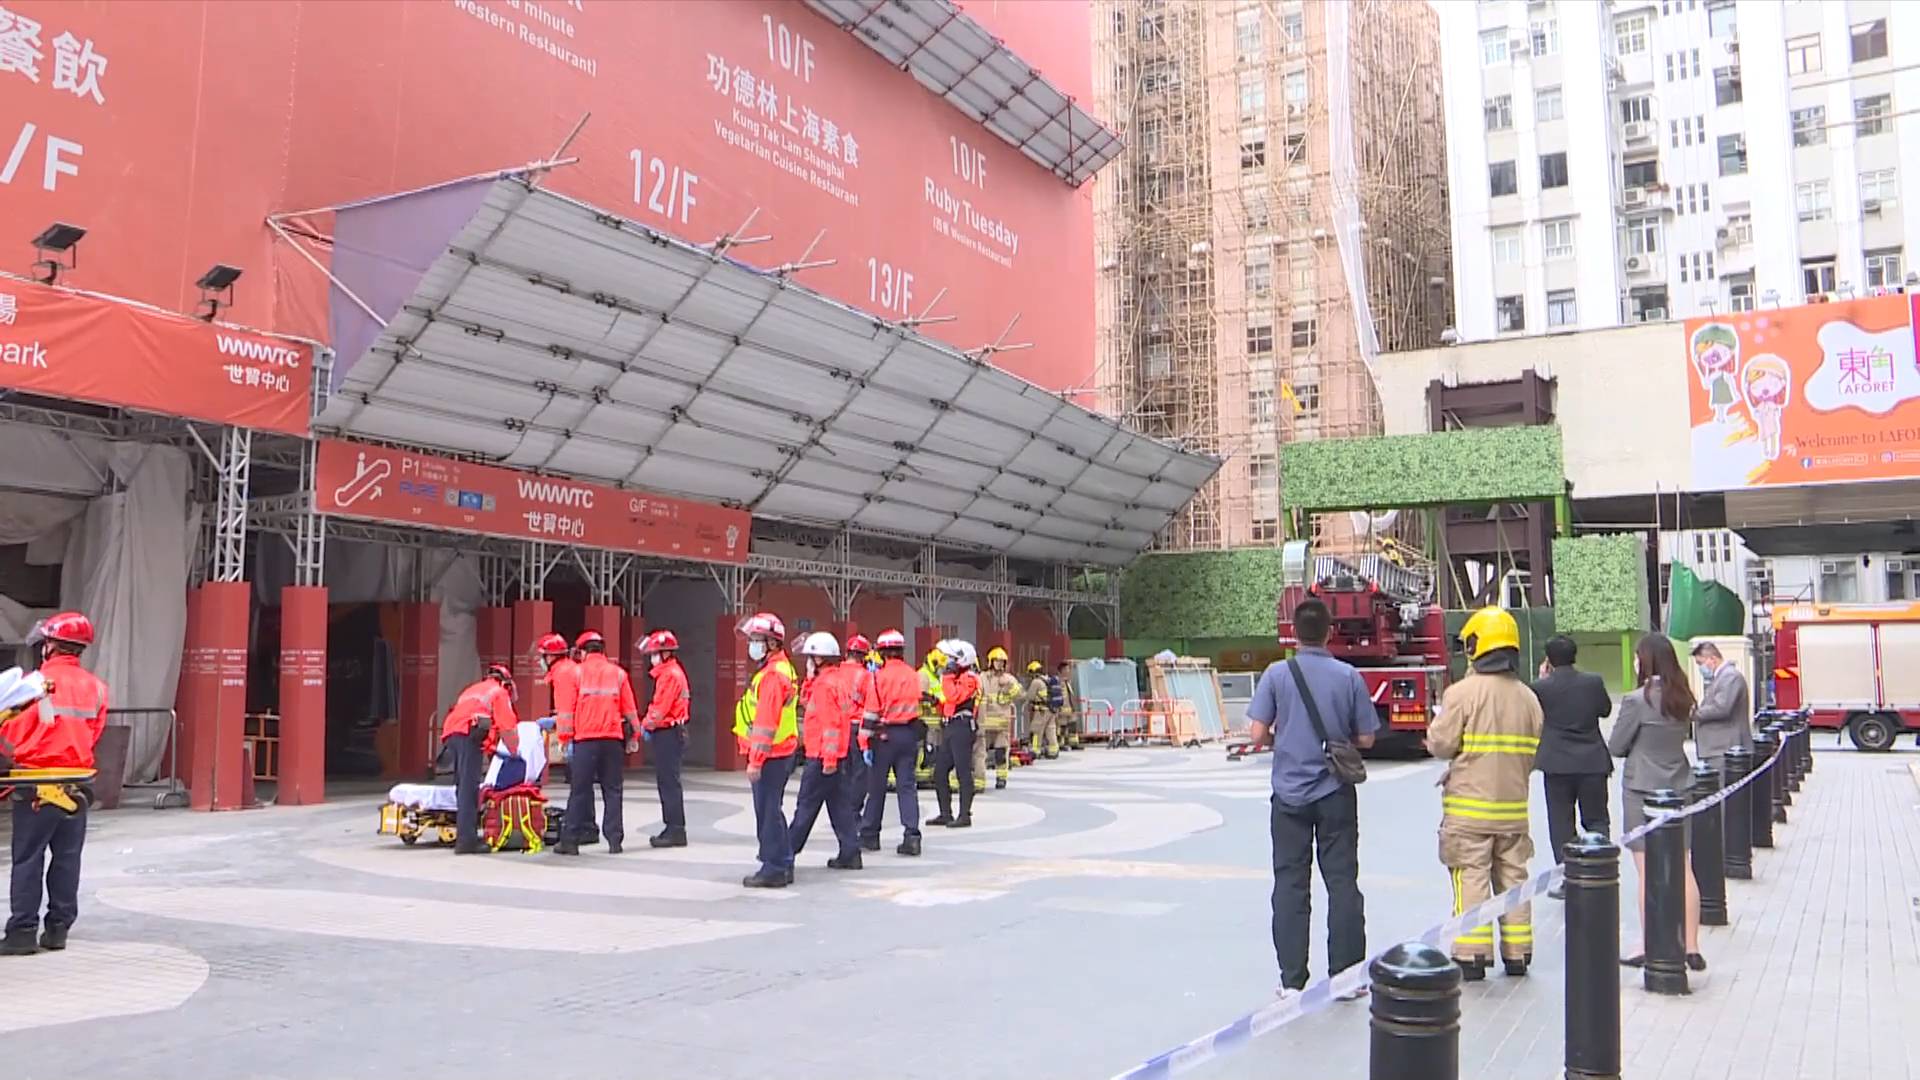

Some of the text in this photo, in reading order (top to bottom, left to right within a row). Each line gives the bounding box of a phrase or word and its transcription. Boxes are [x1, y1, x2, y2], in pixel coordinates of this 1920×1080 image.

[525, 0, 575, 38] minute
[0, 6, 106, 105] 餐飲
[519, 24, 597, 77] Restaurant)
[762, 14, 815, 83] 10/F
[706, 53, 859, 168] 功德林上海素食
[714, 119, 859, 207] Vegetarian Cuisine Restaurant
[732, 107, 845, 180] Kung Tak Lam Shanghai
[950, 135, 986, 190] 10/F
[630, 148, 698, 224] 12/F
[925, 176, 1018, 255] Ruby Tuesday
[868, 257, 913, 315] 13/F
[0, 341, 48, 369] ark
[222, 363, 290, 393] 世貿中心
[402, 457, 420, 476] P1
[1794, 432, 1859, 449] Welcome
[1862, 432, 1876, 445] to
[523, 510, 585, 538] 世貿中心
